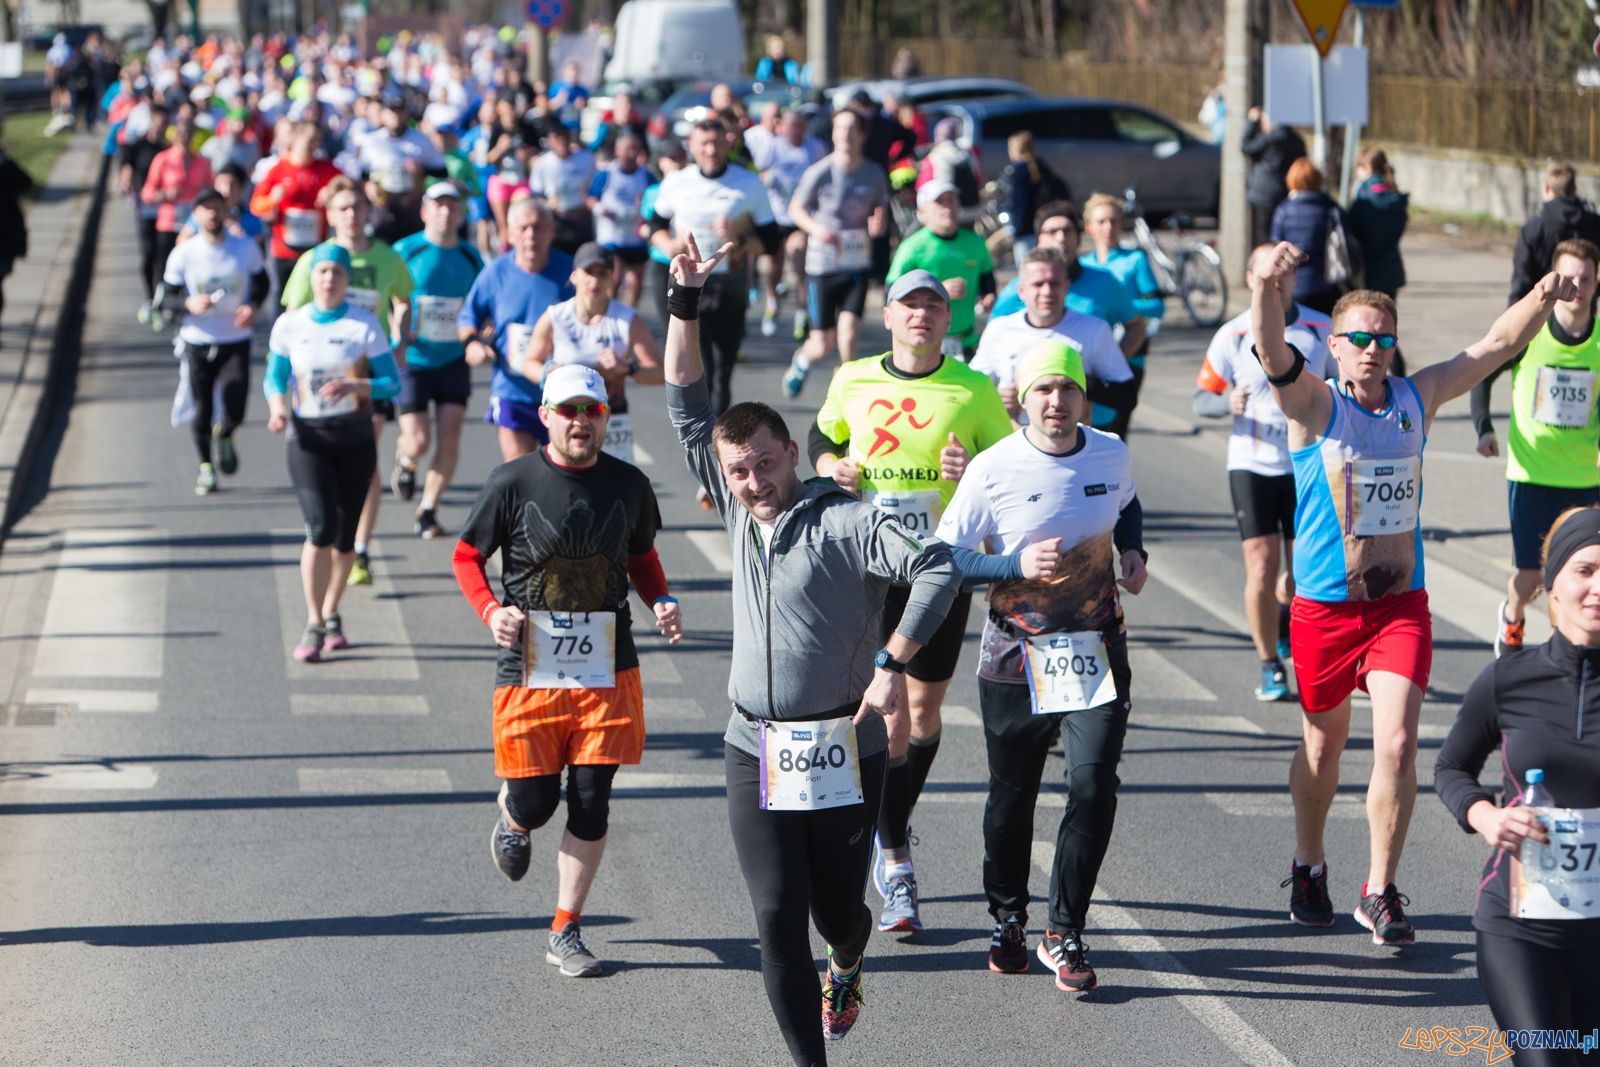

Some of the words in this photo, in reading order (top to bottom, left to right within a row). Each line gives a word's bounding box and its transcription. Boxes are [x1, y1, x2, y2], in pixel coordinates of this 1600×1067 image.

[1549, 386, 1587, 402] 9135
[1364, 479, 1414, 502] 7065
[551, 634, 593, 655] 776
[1044, 655, 1099, 677] 4903
[779, 744, 846, 773] 8640
[806, 775, 822, 783] Piotr
